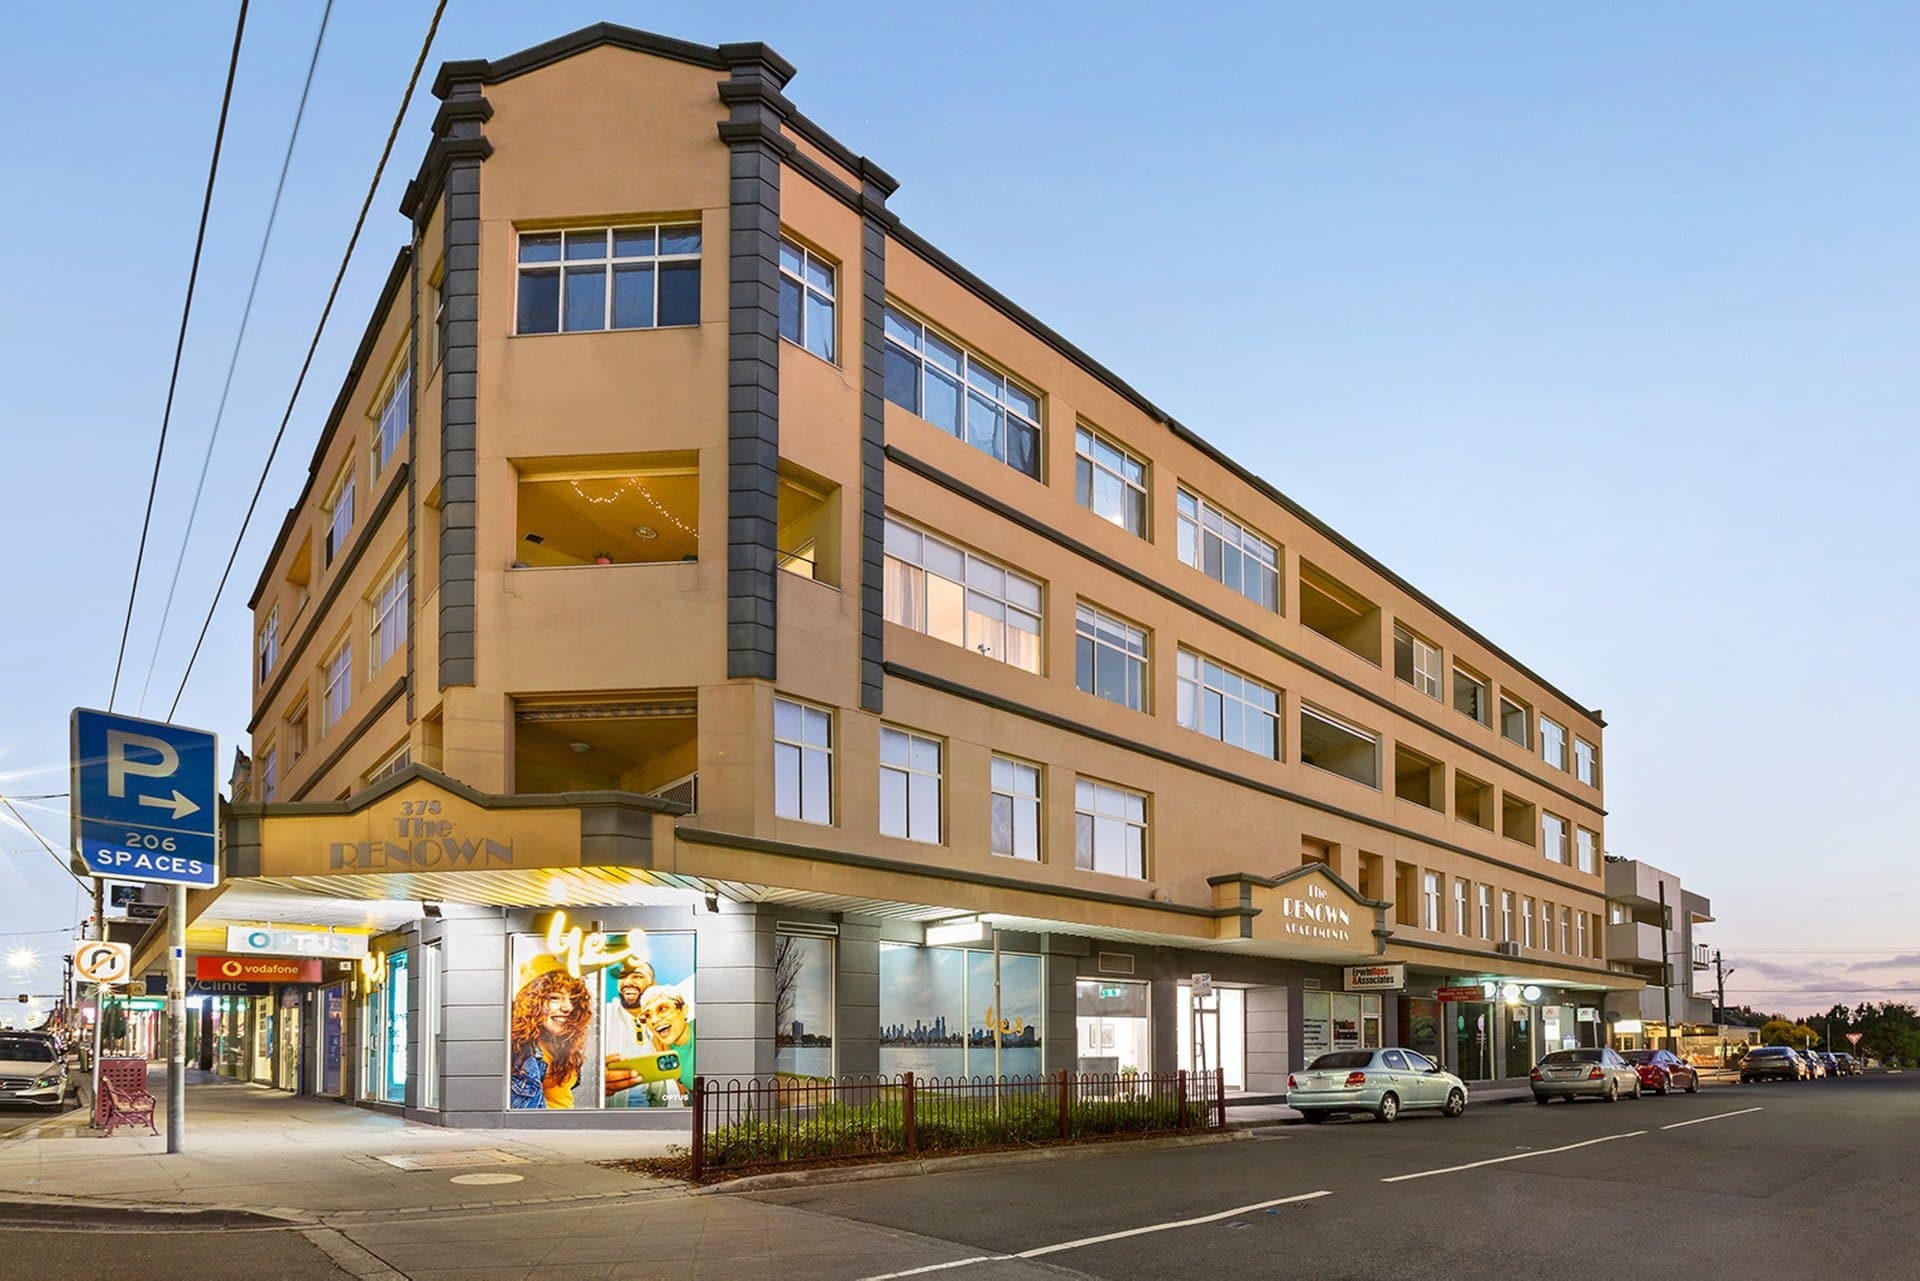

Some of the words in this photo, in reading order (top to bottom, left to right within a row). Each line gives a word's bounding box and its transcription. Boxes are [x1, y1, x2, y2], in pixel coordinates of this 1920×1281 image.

[107, 728, 179, 798] P
[394, 817, 453, 838] The
[125, 832, 177, 851] 206
[97, 849, 203, 875] SPACES
[330, 838, 514, 870] RENOWN
[1307, 884, 1328, 899] The
[1283, 897, 1350, 926] RENOWN
[248, 931, 350, 954] OPTUS
[244, 963, 299, 976] vodafone
